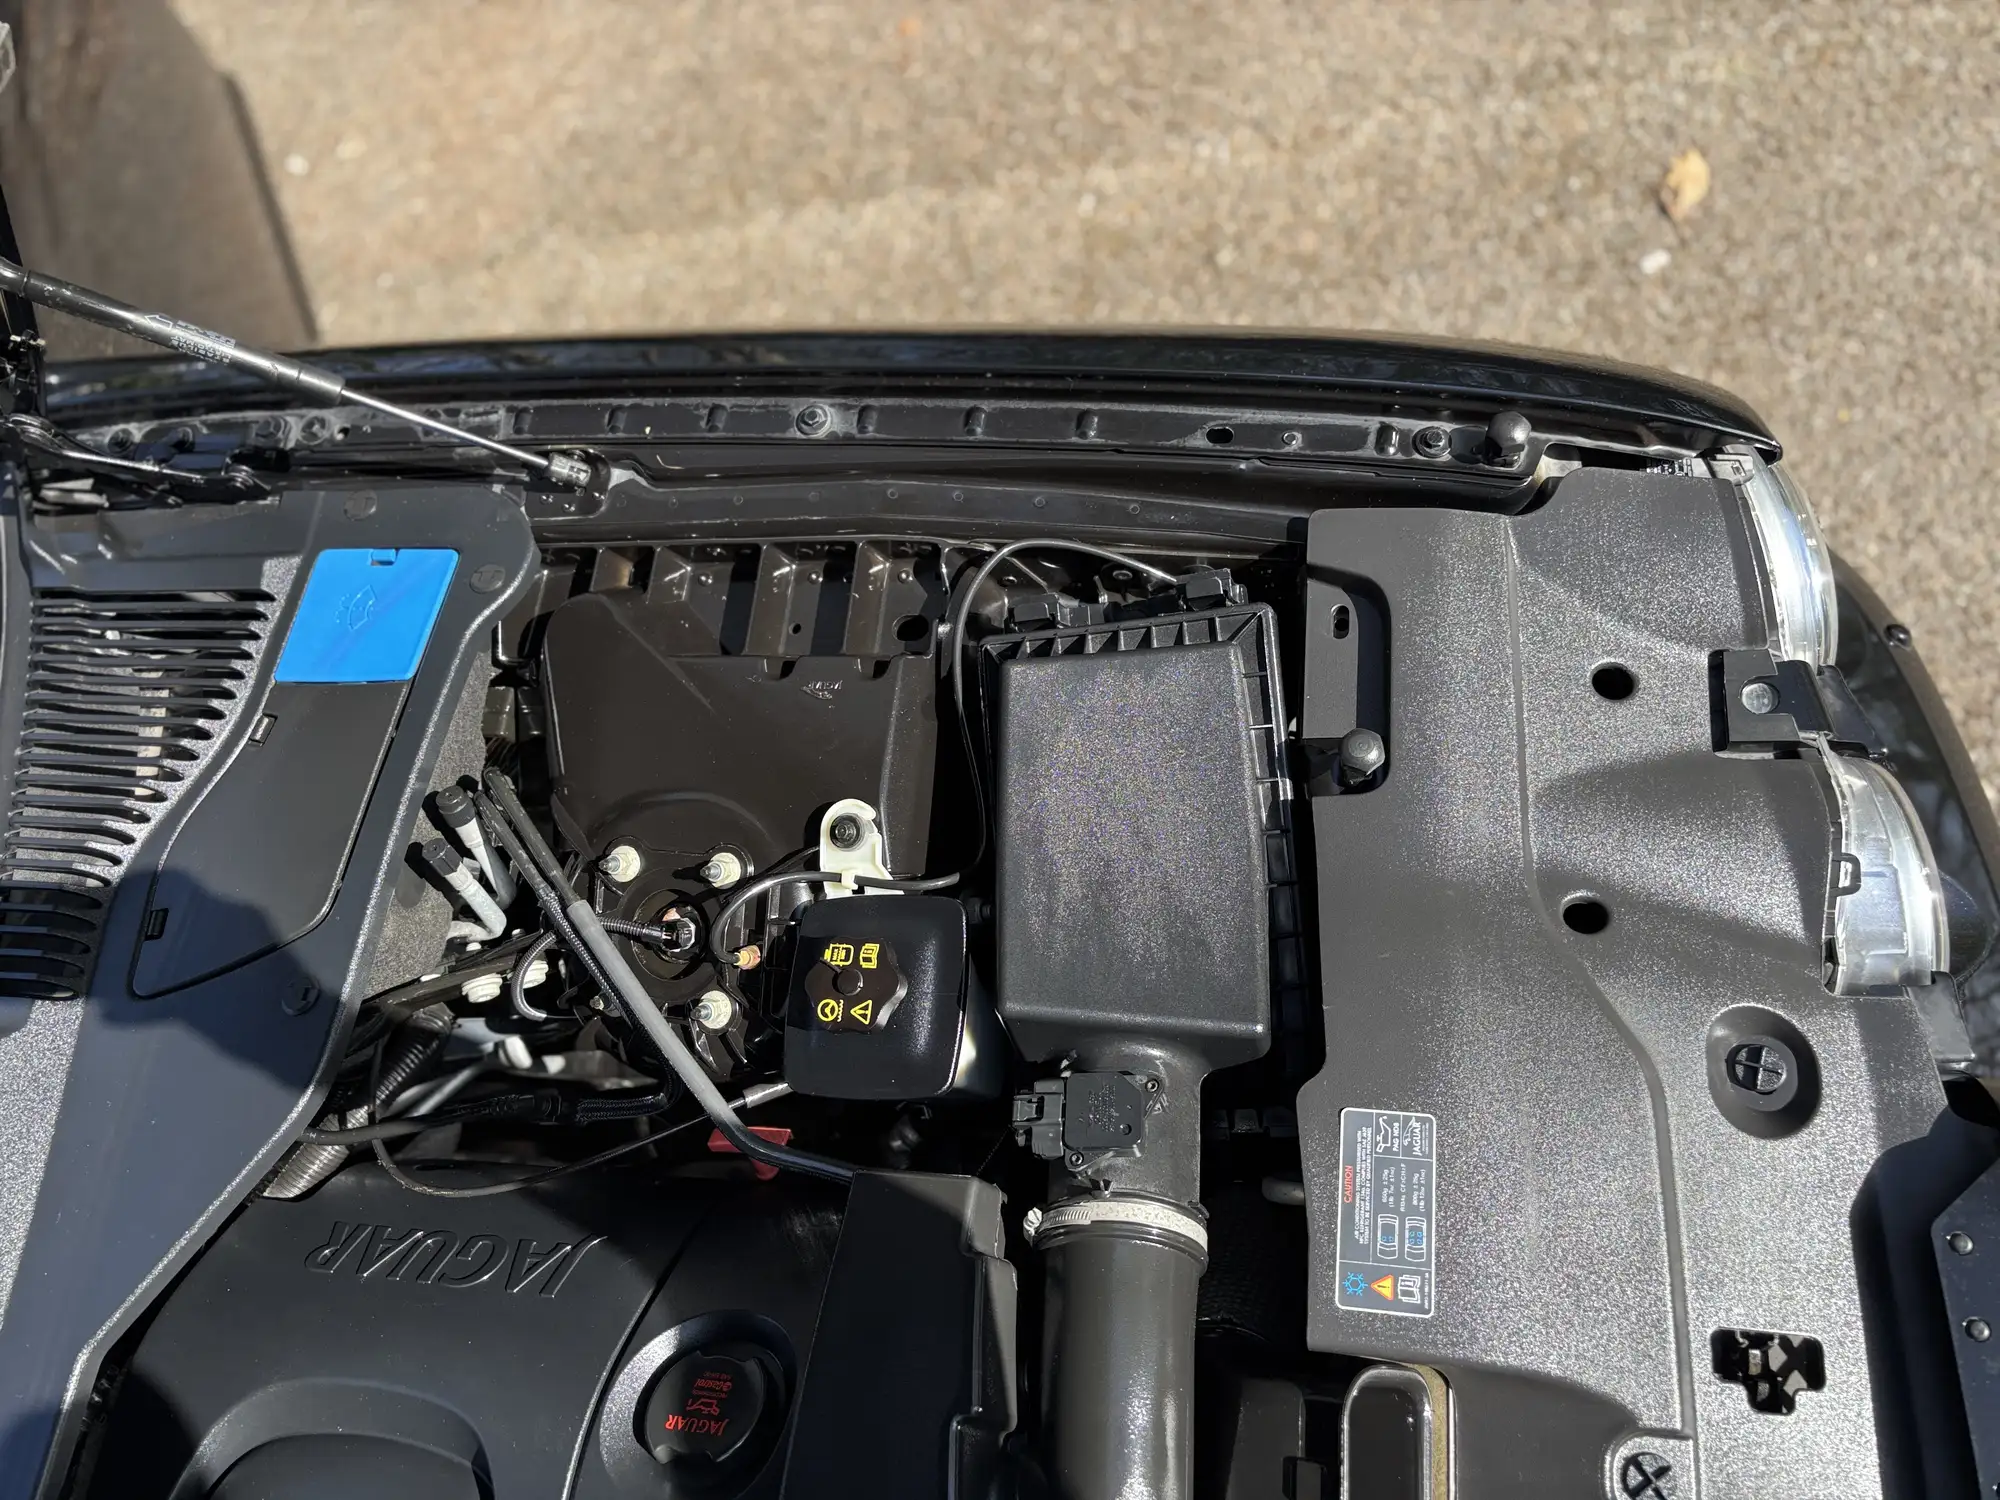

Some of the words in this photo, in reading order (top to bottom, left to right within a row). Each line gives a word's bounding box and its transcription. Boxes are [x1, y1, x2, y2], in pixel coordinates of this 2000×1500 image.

[1412, 1122, 1422, 1156] JAGUAR
[1343, 1165, 1353, 1203] CAUTION
[304, 1221, 608, 1298] JAGUAR
[694, 1379, 723, 1390] Castrol
[664, 1414, 730, 1436] JAGUAR
